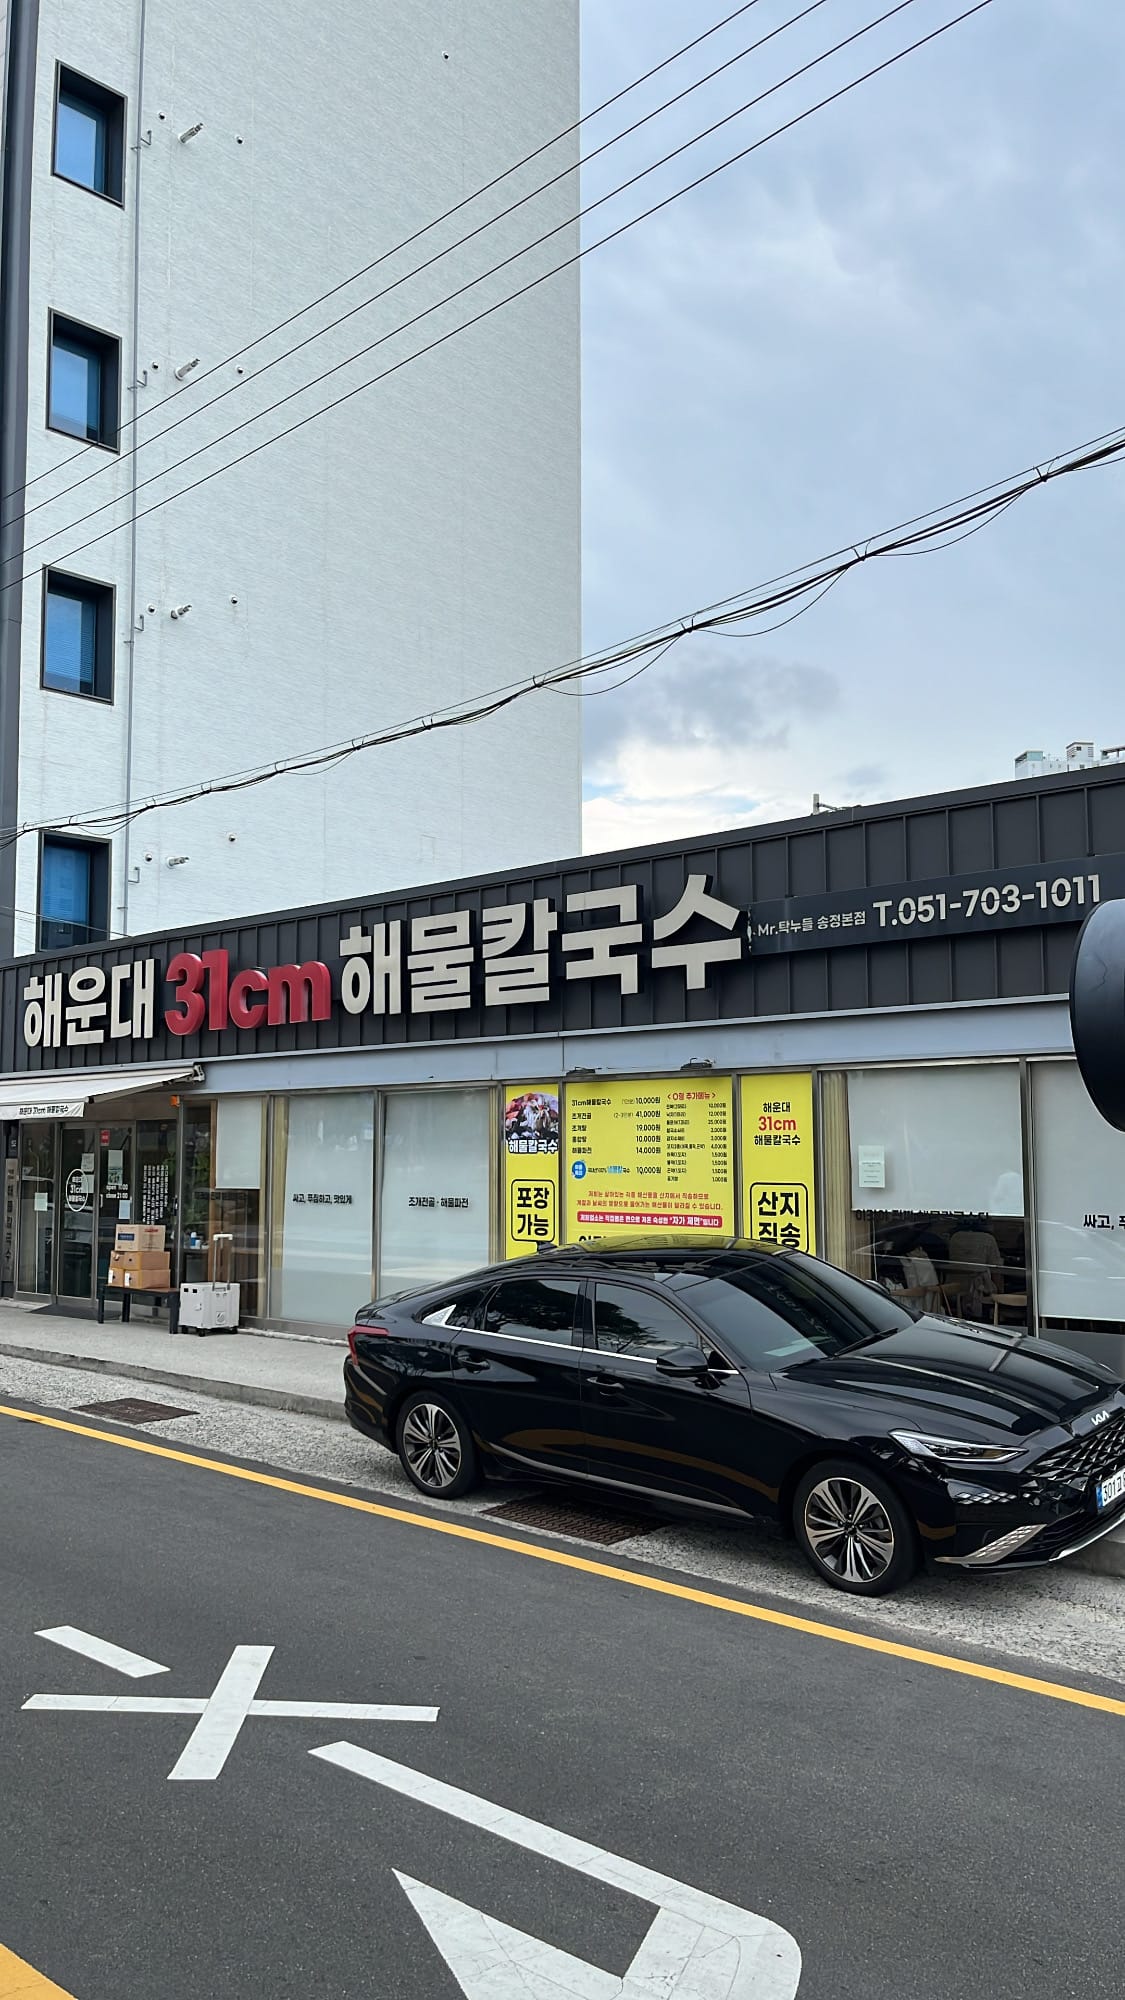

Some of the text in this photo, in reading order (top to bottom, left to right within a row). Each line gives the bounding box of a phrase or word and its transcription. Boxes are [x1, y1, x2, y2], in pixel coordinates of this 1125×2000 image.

[757, 874, 1100, 936] Mr.탁누들 송정본점 T.051-703-1011
[23, 874, 748, 1048] 해운대 31cm 해물칼국수
[635, 1110, 661, 1119] 41,000원
[763, 1101, 791, 1113] 해운대
[758, 1116, 797, 1131] 31cm
[509, 1139, 558, 1153] 해물칼국수
[754, 1134, 801, 1146] 해물칼국수
[408, 1197, 469, 1209] 조개전골 해물파전
[517, 1187, 549, 1209] 포장
[757, 1192, 800, 1217] 산지
[517, 1214, 549, 1236] 가능
[1083, 1214, 1115, 1231] 싸고,
[758, 1222, 801, 1249] 직송
